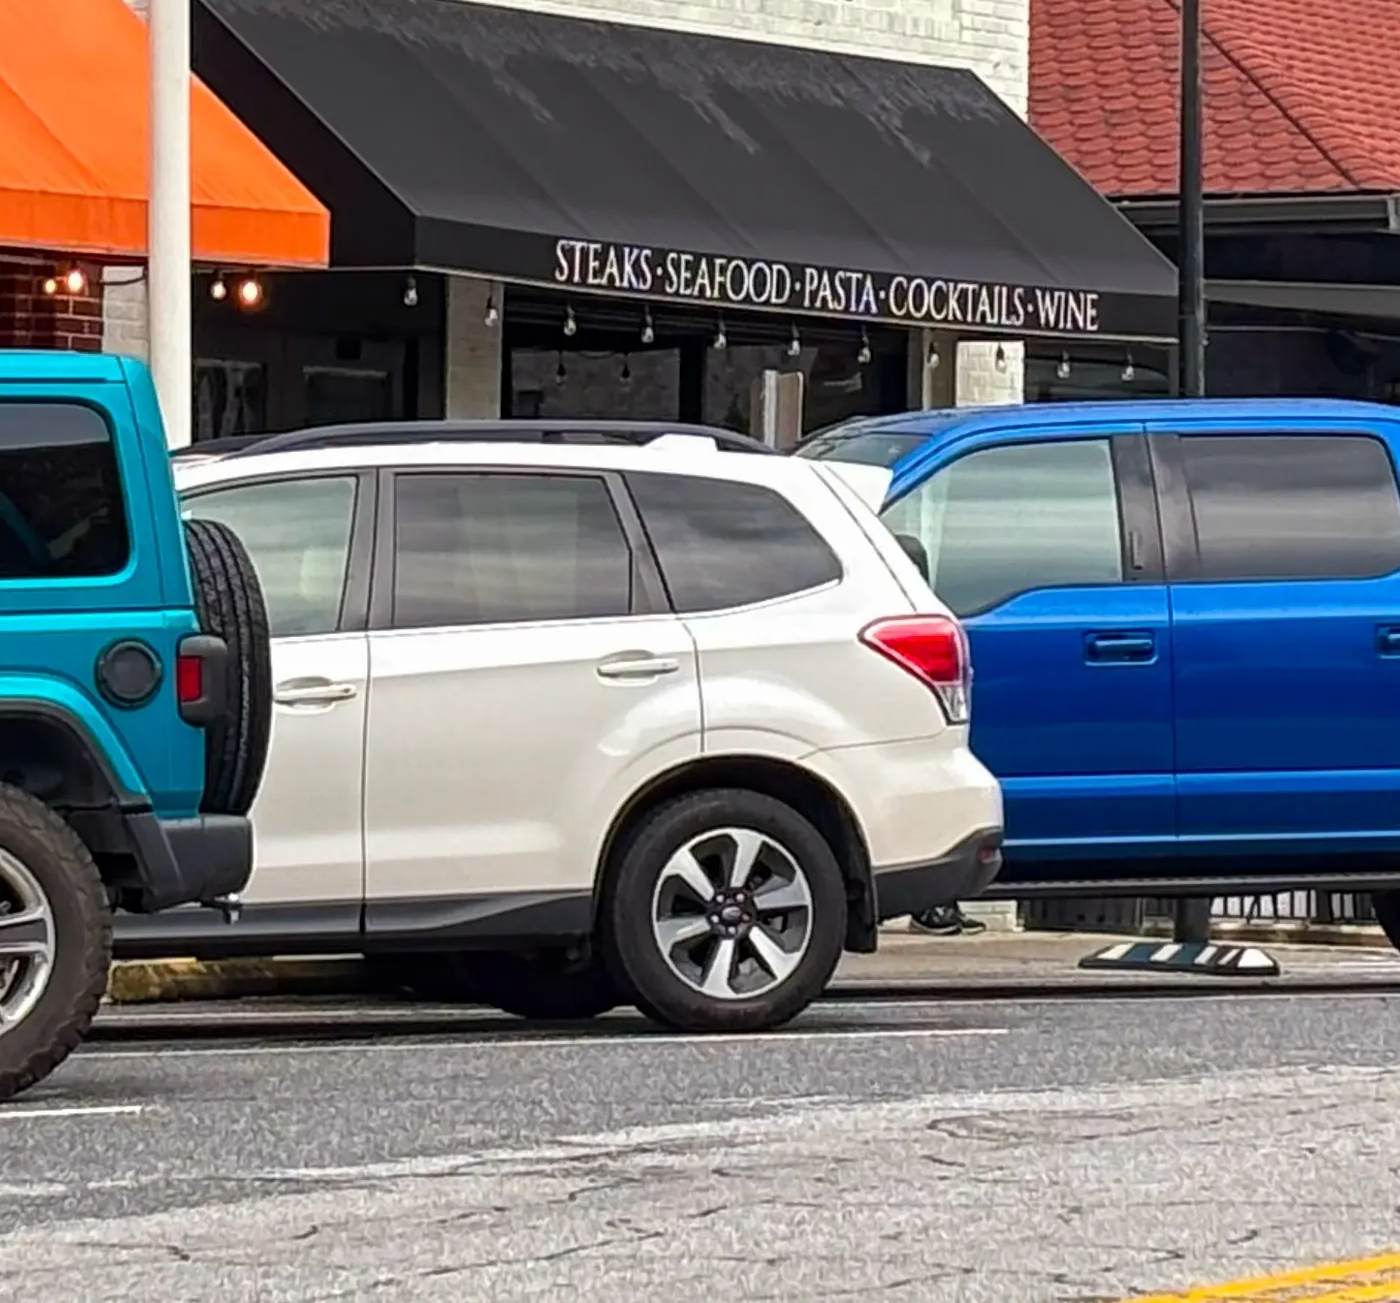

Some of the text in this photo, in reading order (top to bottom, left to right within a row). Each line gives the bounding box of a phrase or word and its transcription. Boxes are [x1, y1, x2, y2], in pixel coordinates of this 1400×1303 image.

[554, 239, 1100, 332] STEAKS SEAFOOD PASTA COCKTAILS WINE
